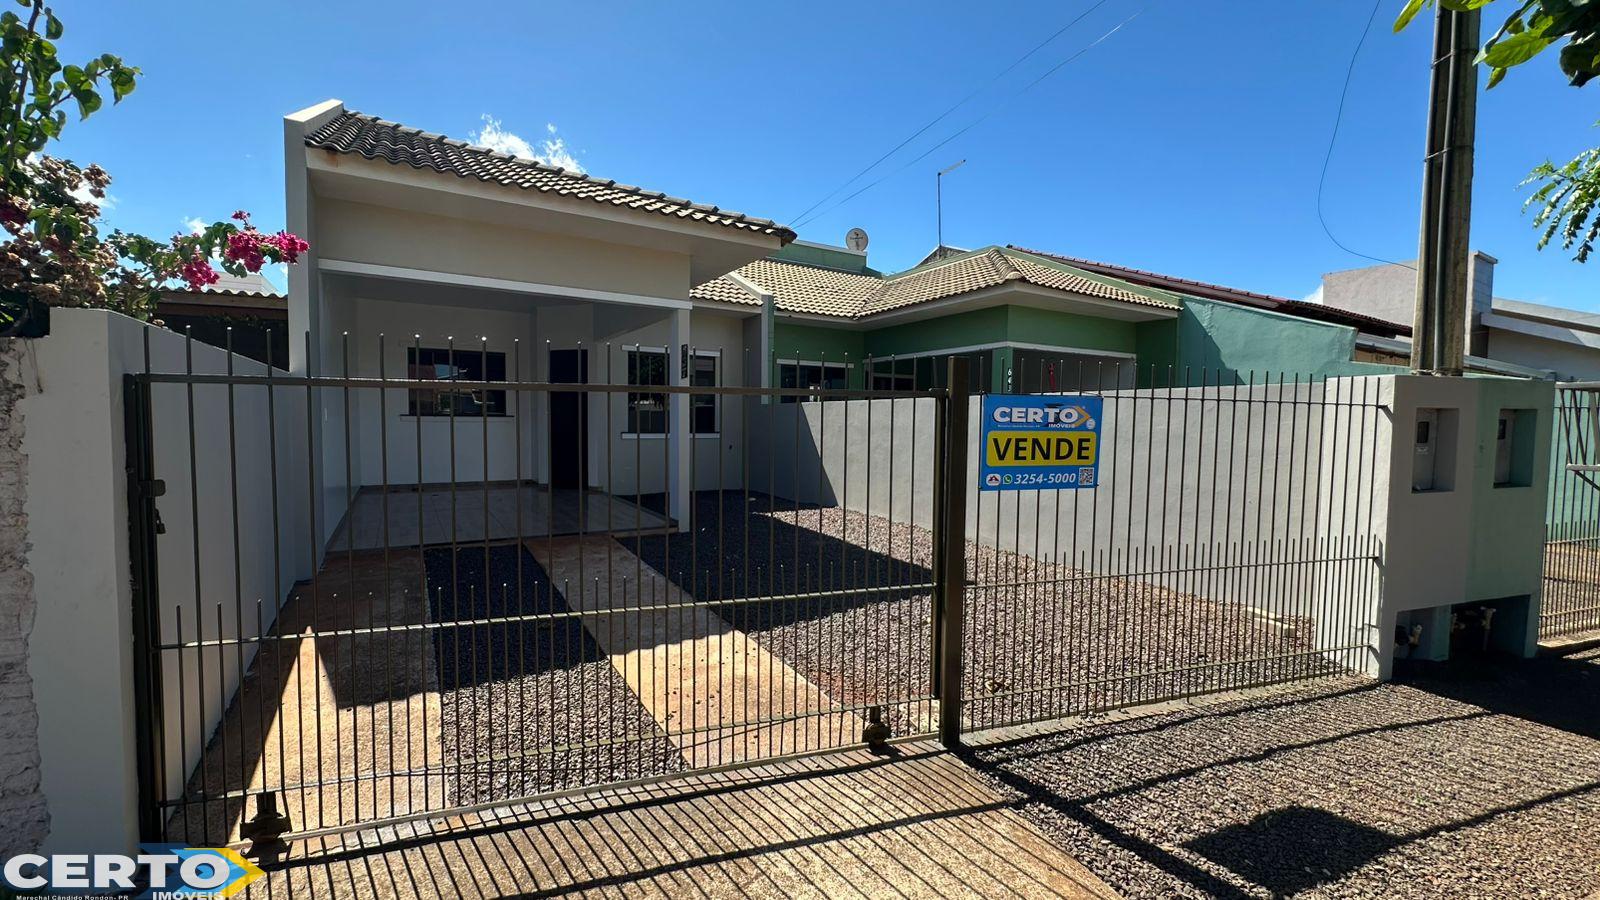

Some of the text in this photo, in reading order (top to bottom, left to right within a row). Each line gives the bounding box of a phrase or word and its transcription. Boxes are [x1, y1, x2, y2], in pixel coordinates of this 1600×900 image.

[993, 406, 1079, 423] CERTO
[992, 437, 1091, 461] VENDE
[1013, 473, 1077, 484] 3254-5000
